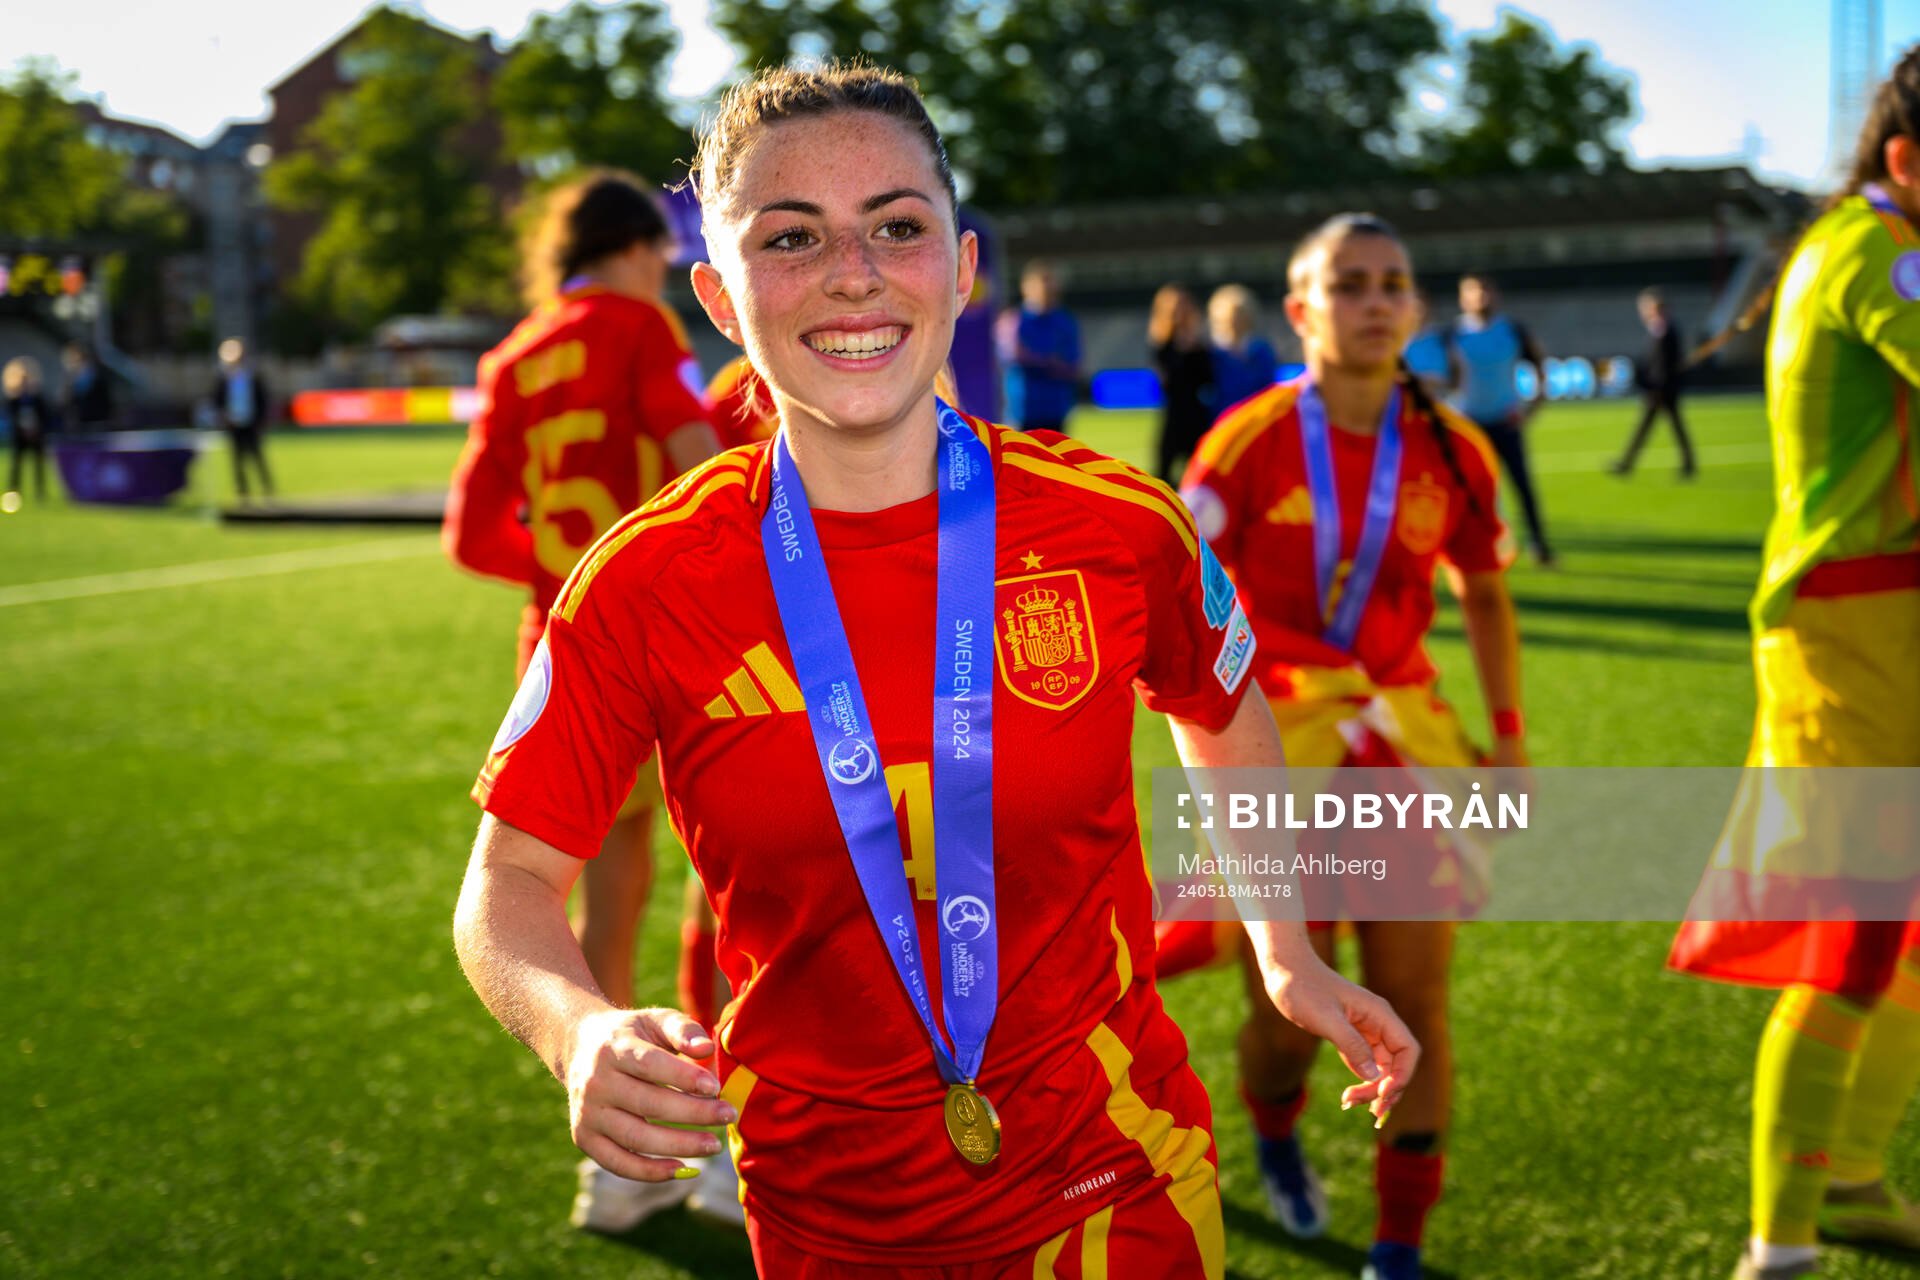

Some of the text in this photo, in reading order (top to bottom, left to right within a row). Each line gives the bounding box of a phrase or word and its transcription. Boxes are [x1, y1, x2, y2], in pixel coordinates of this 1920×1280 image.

[954, 442, 966, 491] UNDER-17
[772, 484, 803, 562] SWEDEN
[831, 682, 854, 737] UNDER-17
[952, 619, 973, 761] SWEDEN 2024
[892, 914, 915, 965] 2024
[957, 942, 969, 998] UNDER-17
[1063, 1170, 1117, 1201] AEROREADY
